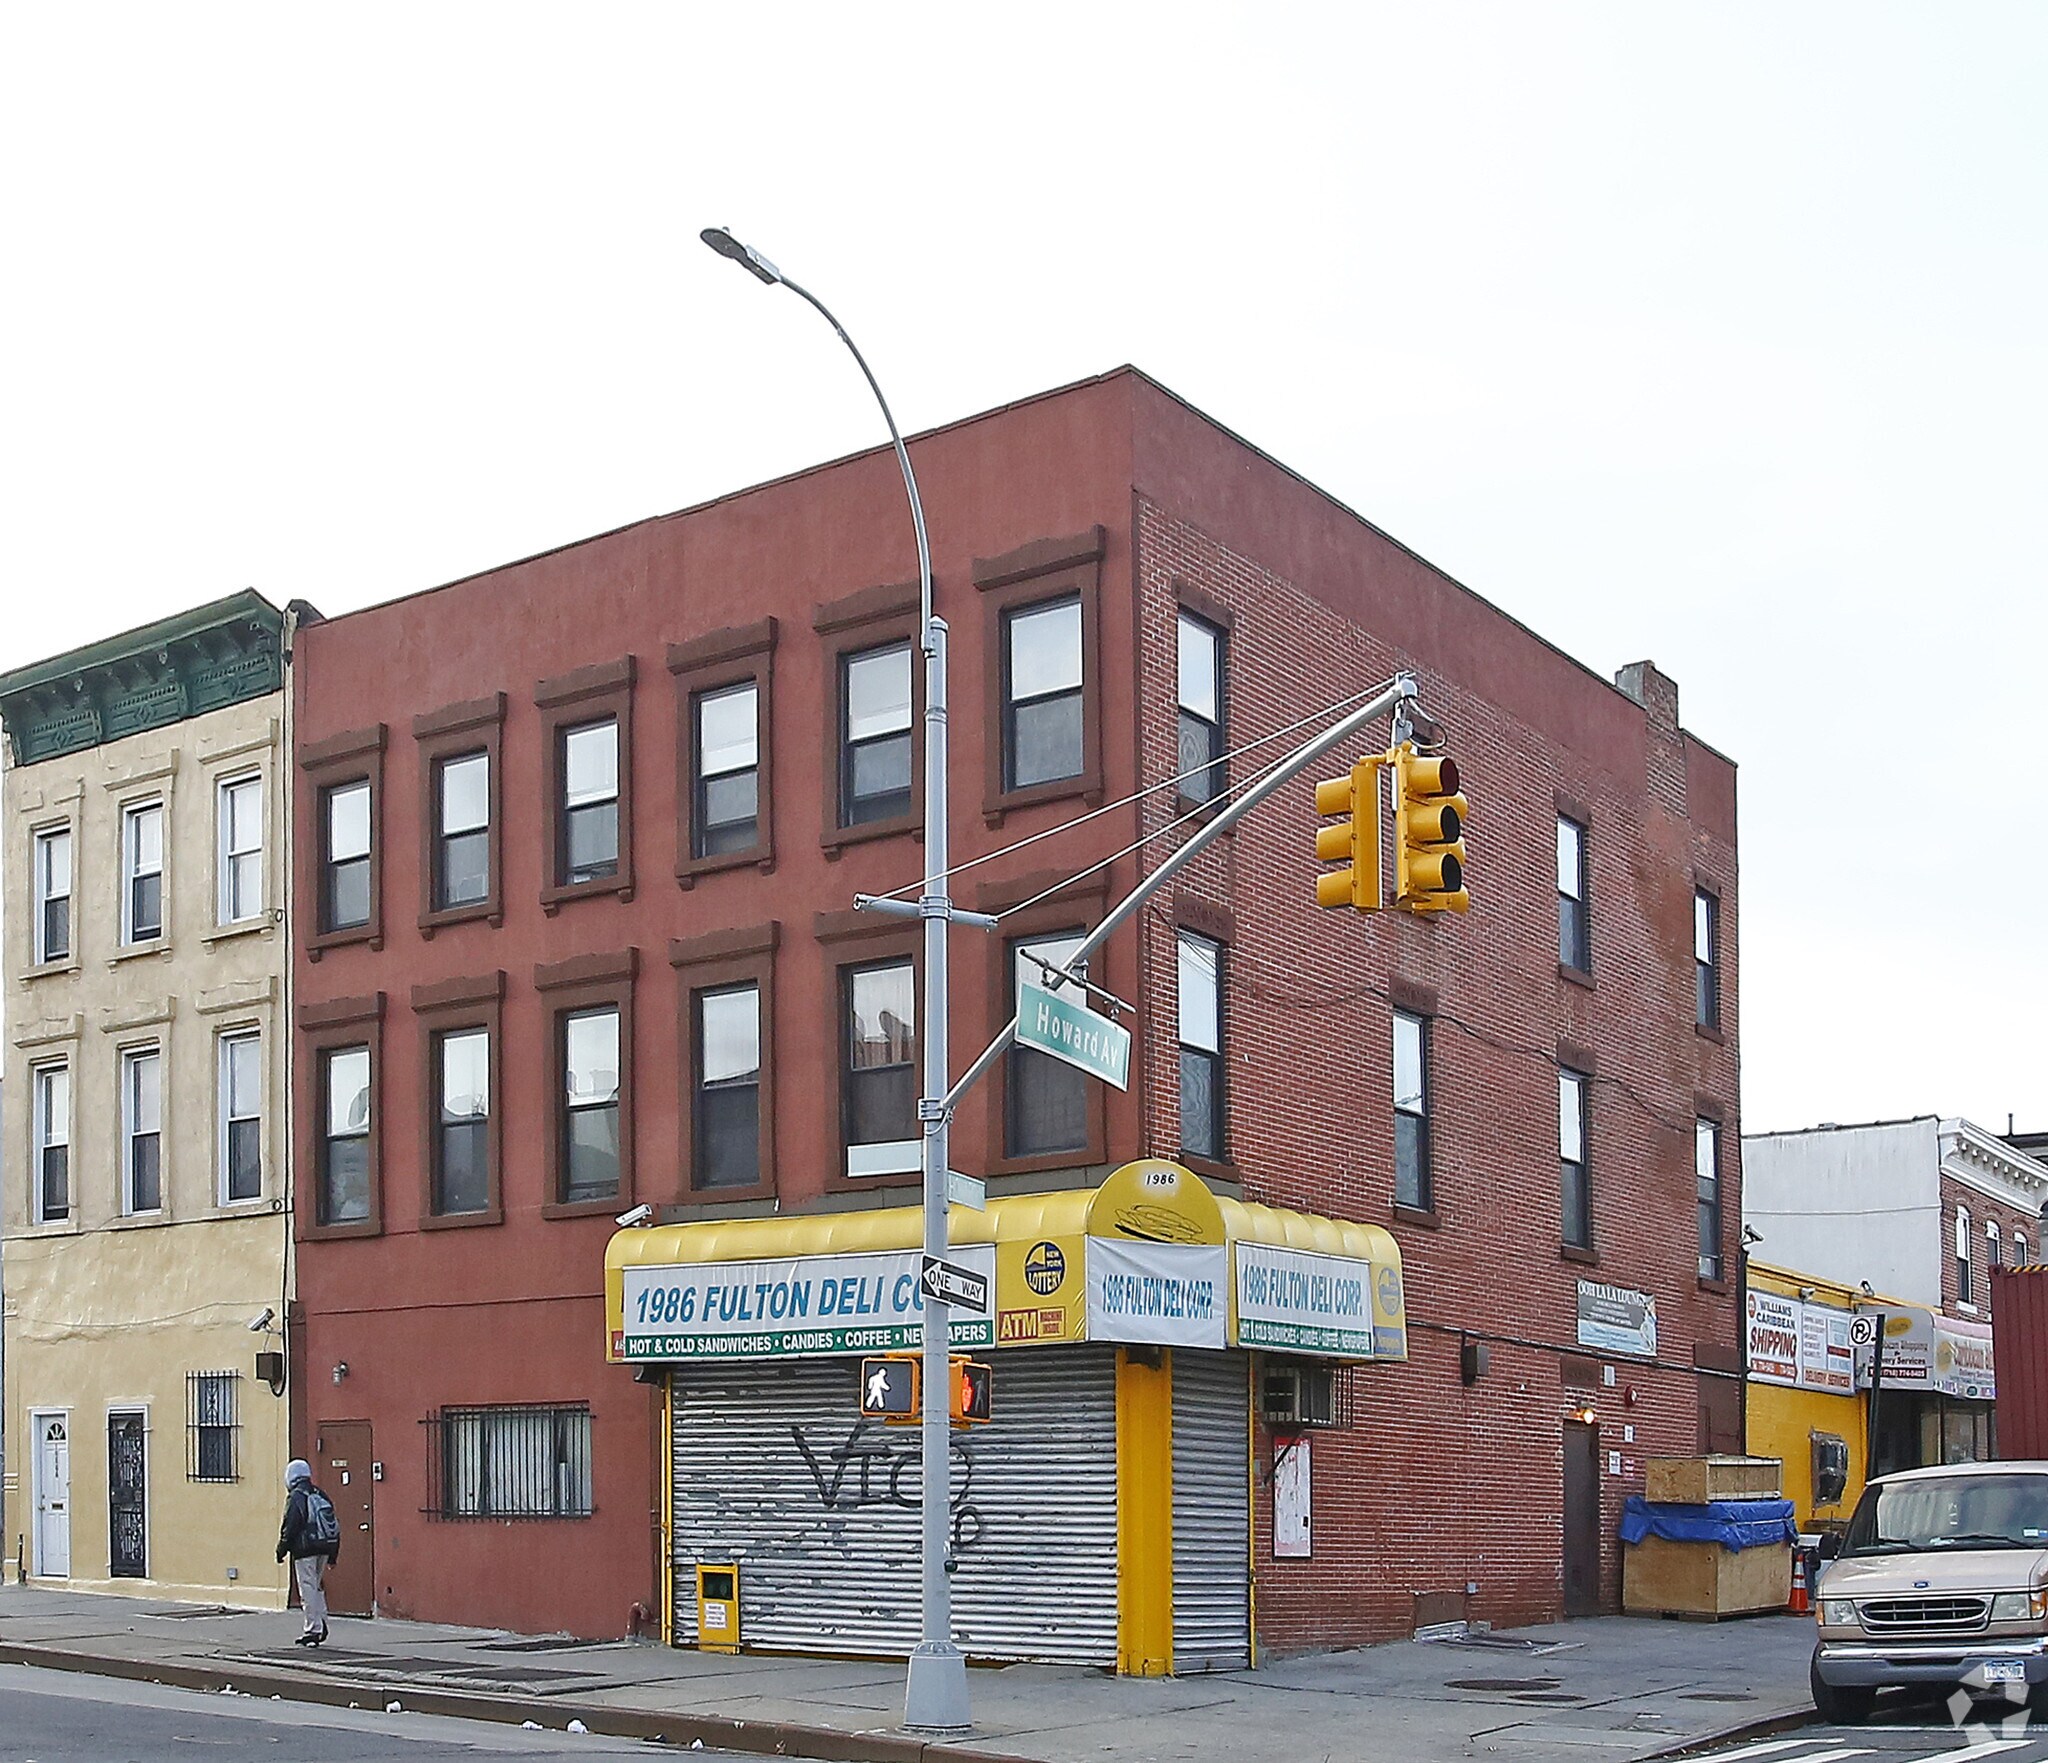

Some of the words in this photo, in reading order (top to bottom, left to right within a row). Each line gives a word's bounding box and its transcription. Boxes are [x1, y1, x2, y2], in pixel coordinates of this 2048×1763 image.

[1037, 1001, 1099, 1058] Howard
[1146, 1173, 1176, 1186] 1986
[1046, 1250, 1060, 1259] NEW
[1046, 1259, 1063, 1268] YORK
[928, 1269, 951, 1290] ONE
[961, 1280, 983, 1300] WAY
[1028, 1270, 1062, 1292] LOTTERY
[1243, 1264, 1267, 1305] 1986
[1269, 1269, 1309, 1311] FULTON
[1311, 1274, 1333, 1313] DELI
[1336, 1278, 1363, 1317] CORP.
[636, 1286, 698, 1323] 1986
[702, 1280, 811, 1322] FULTON
[817, 1275, 885, 1316] DELI
[1103, 1274, 1124, 1314] 1986
[1125, 1276, 1161, 1316] FULTON
[1163, 1279, 1185, 1318] DELI
[1760, 1300, 1792, 1317] WILLIAMS
[1001, 1311, 1037, 1339] ATM
[1756, 1312, 1796, 1330] CARIBBEAN
[629, 1339, 651, 1354] HOT
[655, 1338, 664, 1352] &
[665, 1337, 699, 1353] COLD
[697, 1335, 772, 1352] SANDWICHES
[782, 1332, 833, 1350] CANDIES
[845, 1329, 891, 1347] COFFEE
[903, 1324, 987, 1344] NEAPERS
[1750, 1326, 1797, 1358] SHIPPING
